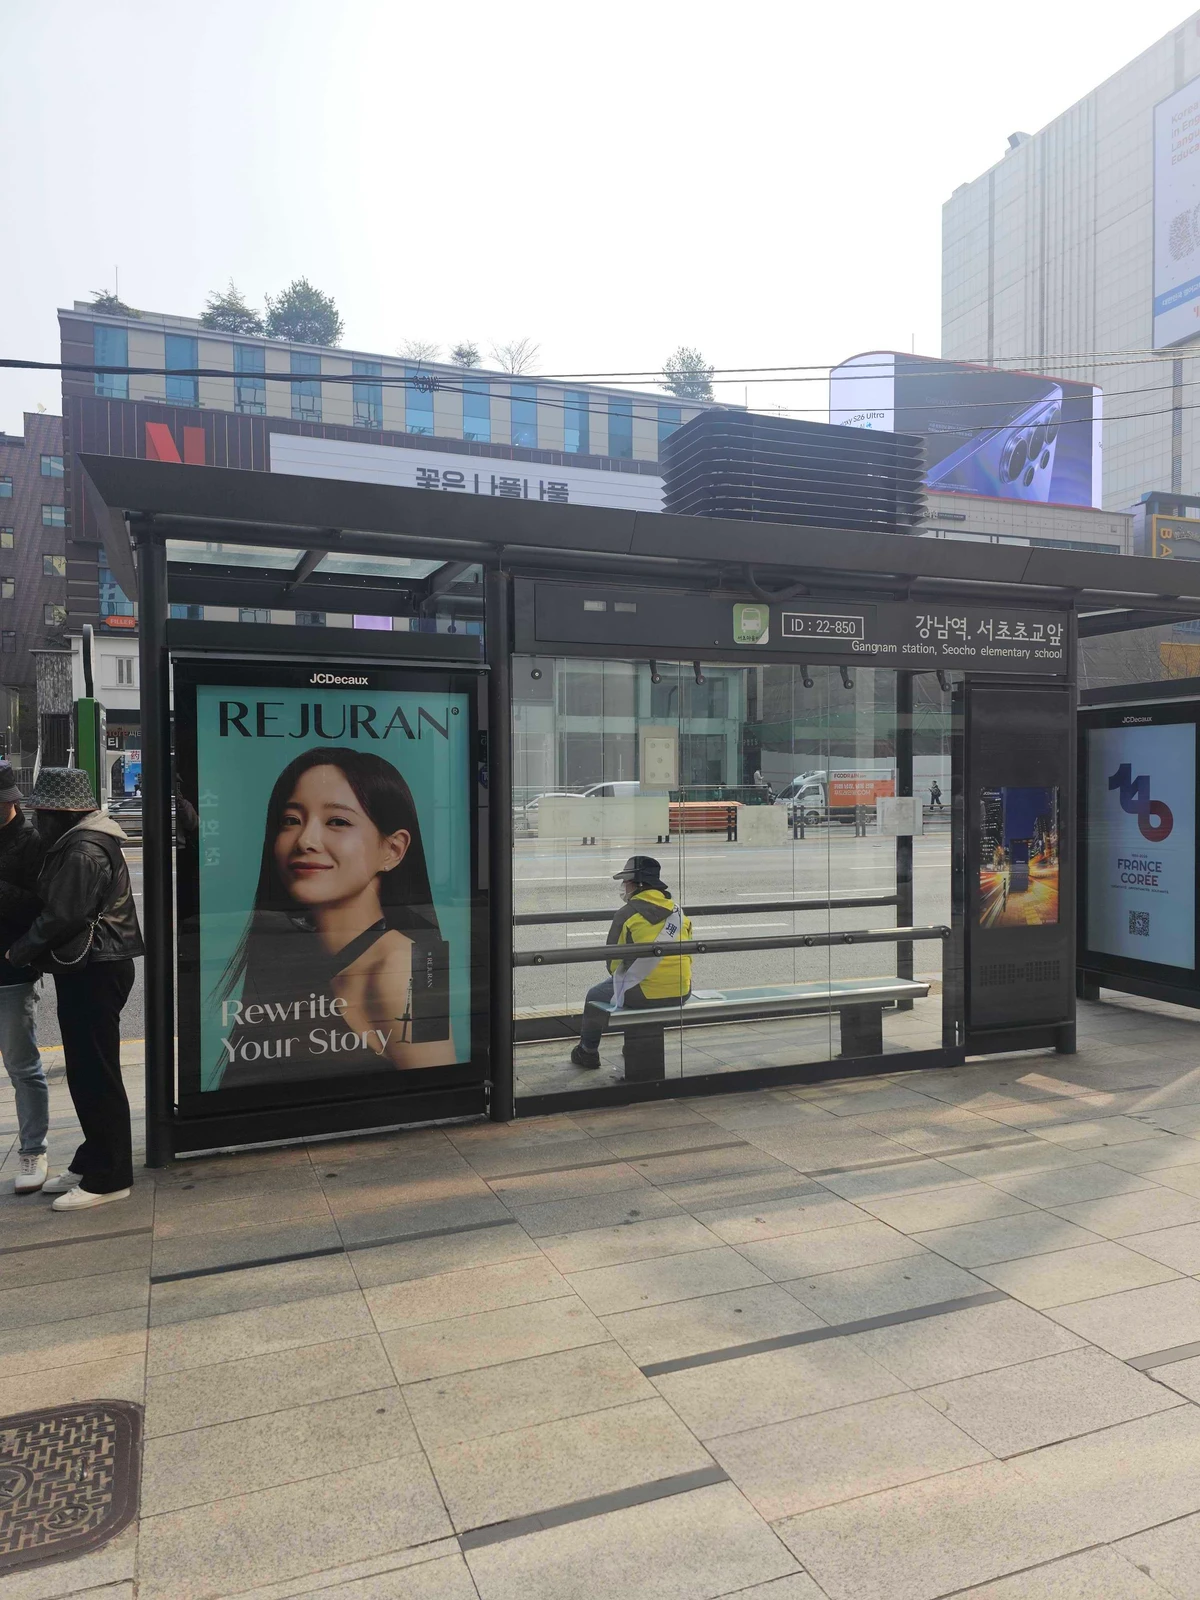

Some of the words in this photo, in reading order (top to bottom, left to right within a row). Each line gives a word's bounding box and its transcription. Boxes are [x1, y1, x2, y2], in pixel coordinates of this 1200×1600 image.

[853, 414, 865, 423] S26
[866, 412, 885, 420] Ultra
[791, 618, 804, 632] ID
[816, 619, 856, 634] 22-850
[977, 619, 1064, 646] 서초초교앞
[851, 640, 897, 654] Gangnam
[902, 643, 938, 656] station,
[942, 644, 976, 656] Seocho
[980, 647, 1031, 660] elementary
[1034, 648, 1063, 659] school
[309, 673, 369, 686] JCDecaux
[1117, 858, 1162, 873] FRANCE
[1120, 872, 1159, 886] CORÉE
[221, 993, 349, 1028] Rewrite
[221, 1034, 300, 1064] Your
[308, 1025, 394, 1055] Story
